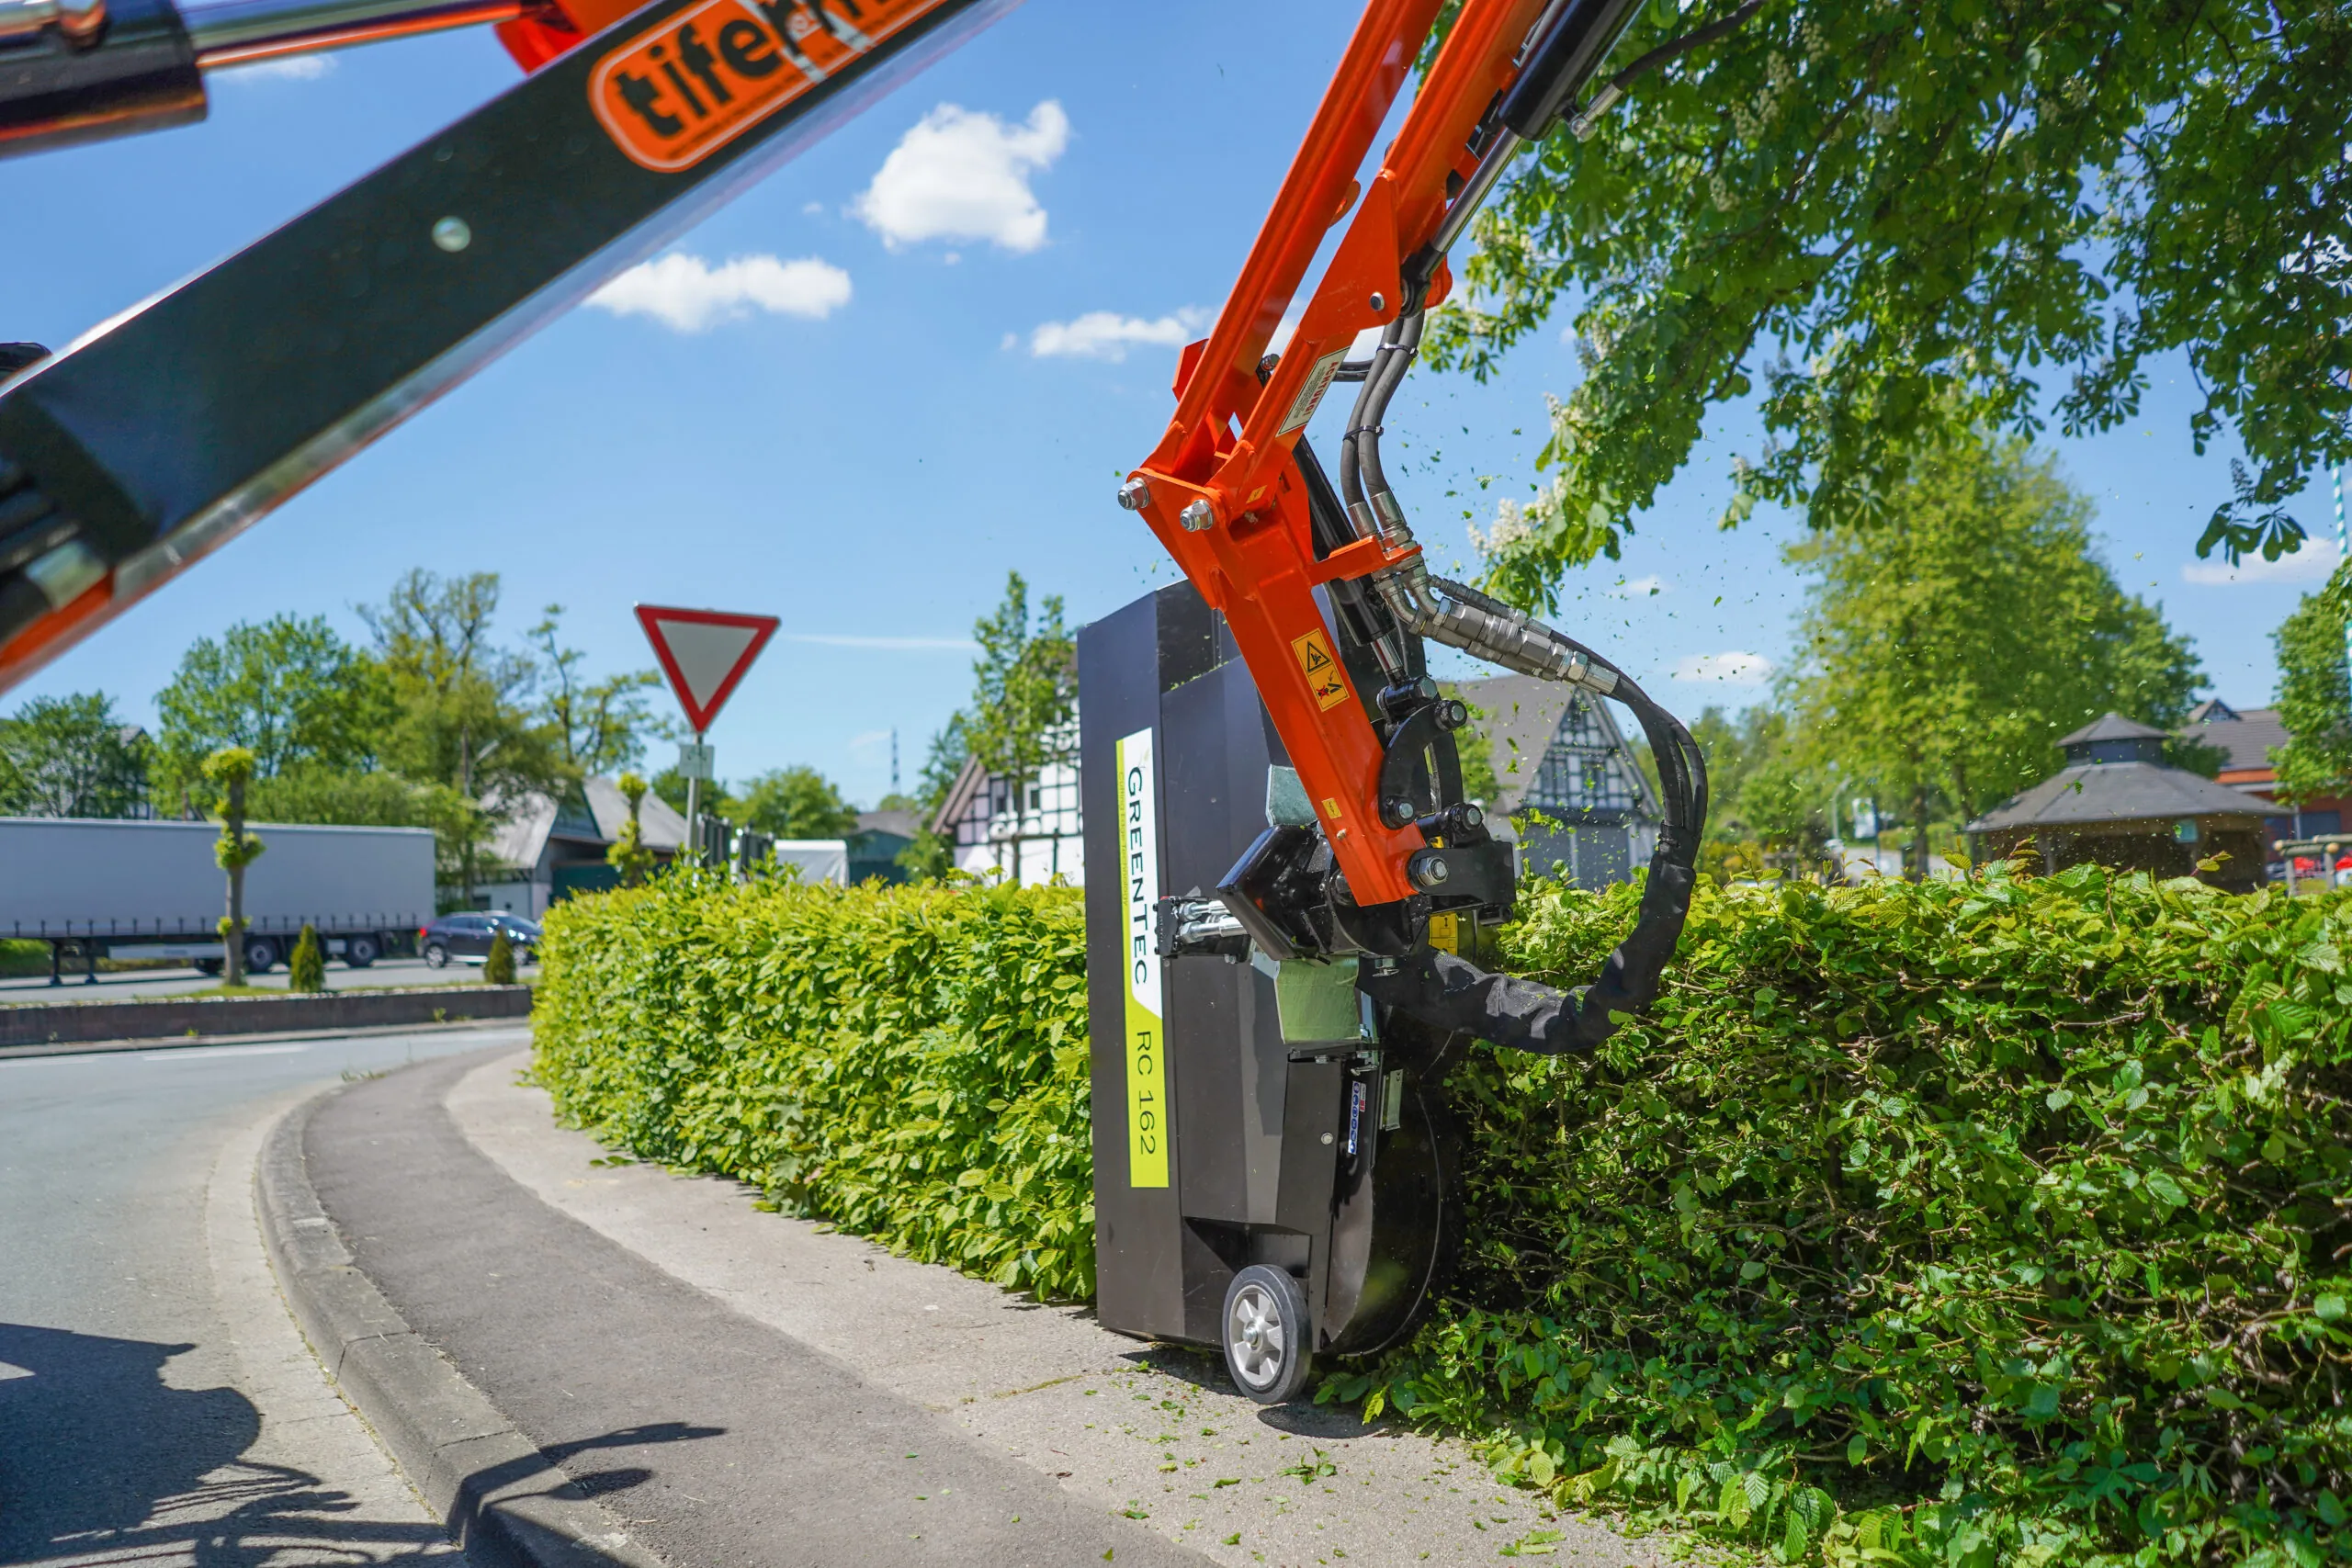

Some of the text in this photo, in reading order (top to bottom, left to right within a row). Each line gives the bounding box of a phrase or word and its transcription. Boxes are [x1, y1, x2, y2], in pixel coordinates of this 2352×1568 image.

[616, 0, 887, 136] tifer
[1302, 361, 1339, 416] ACHTUNG!
[1128, 766, 1148, 985] GREENTEC
[1137, 1032, 1156, 1155] RC 162
